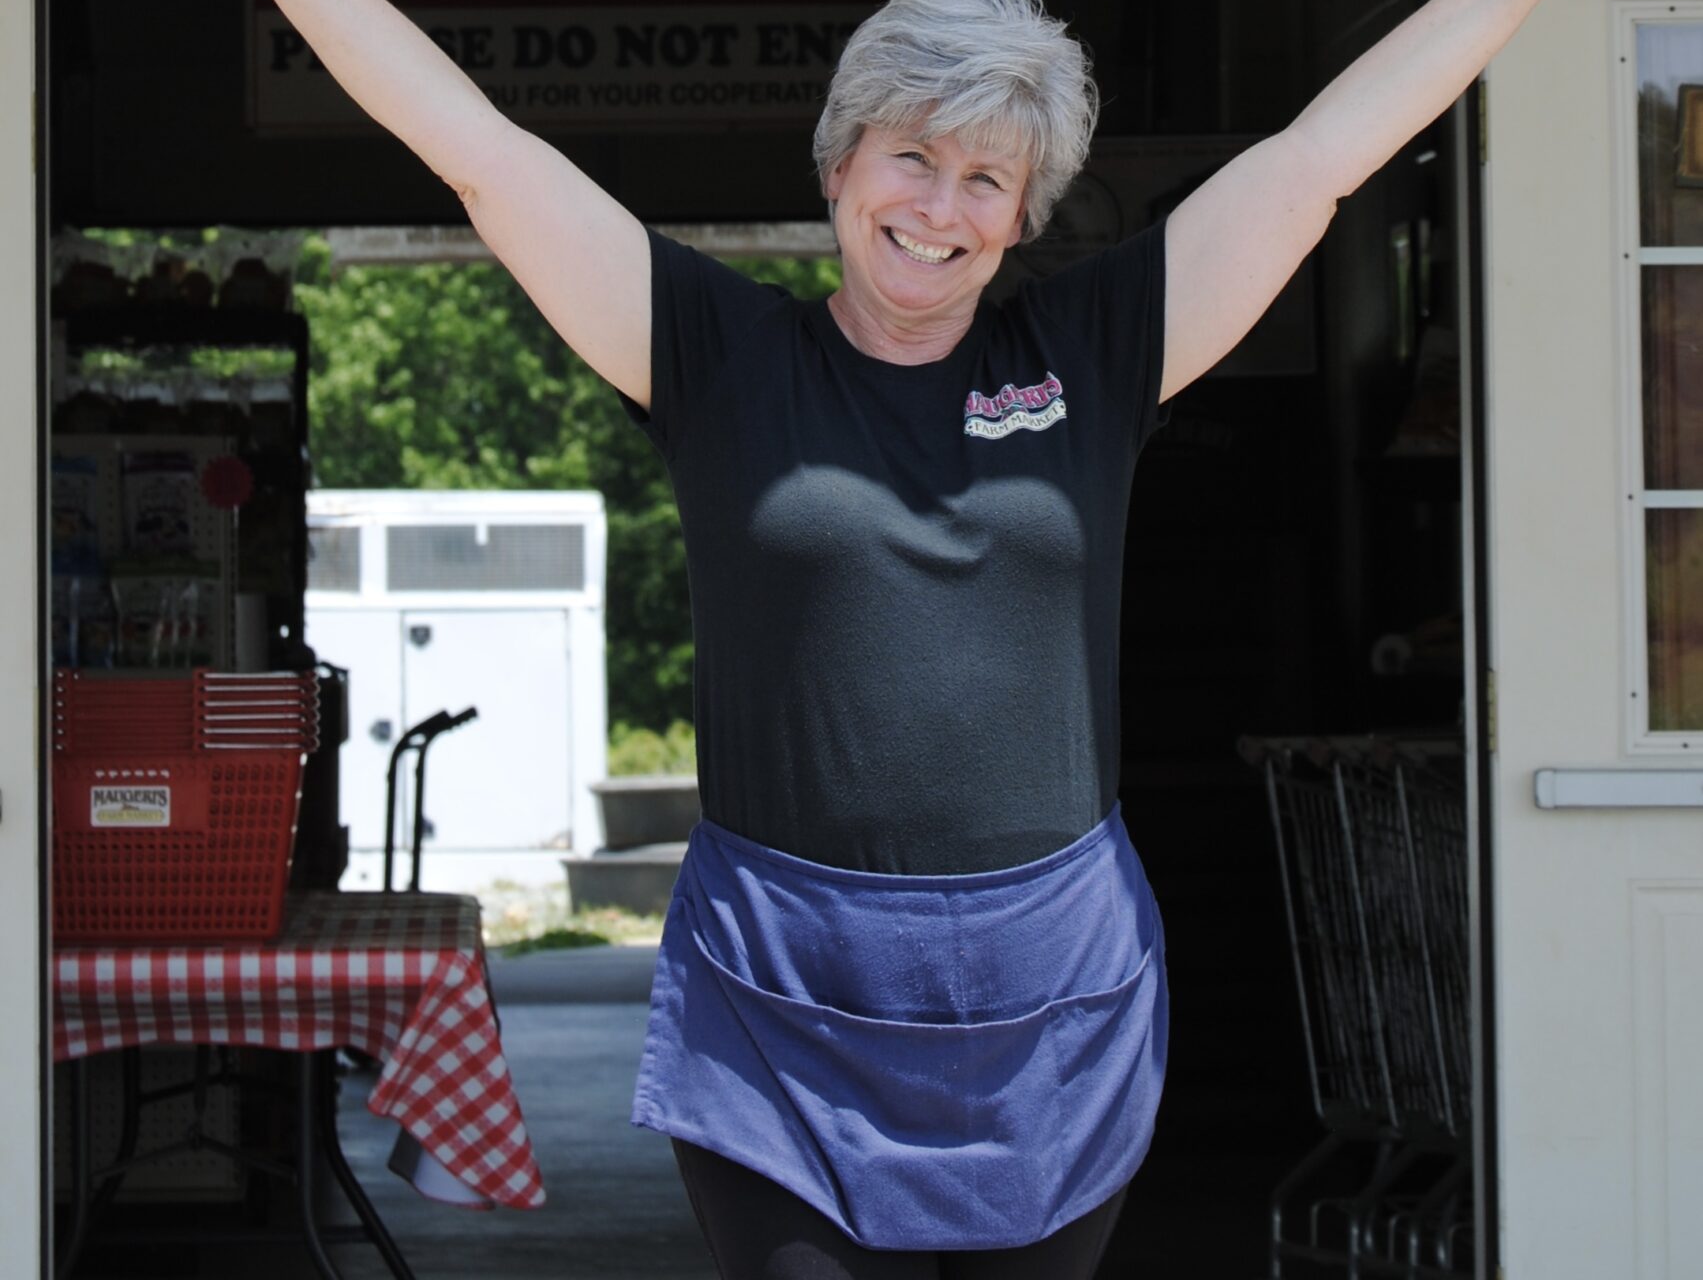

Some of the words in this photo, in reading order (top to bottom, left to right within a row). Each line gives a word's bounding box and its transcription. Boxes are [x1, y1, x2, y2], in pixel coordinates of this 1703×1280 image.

[270, 25, 493, 71] PSE
[514, 25, 596, 70] DO
[616, 24, 738, 68] NOT
[488, 84, 518, 107] OU
[529, 84, 585, 107] FOR
[592, 83, 662, 107] YOUR
[669, 81, 825, 105] COOPERATI
[974, 421, 1009, 436] FARM
[1010, 406, 1059, 428] MARKET
